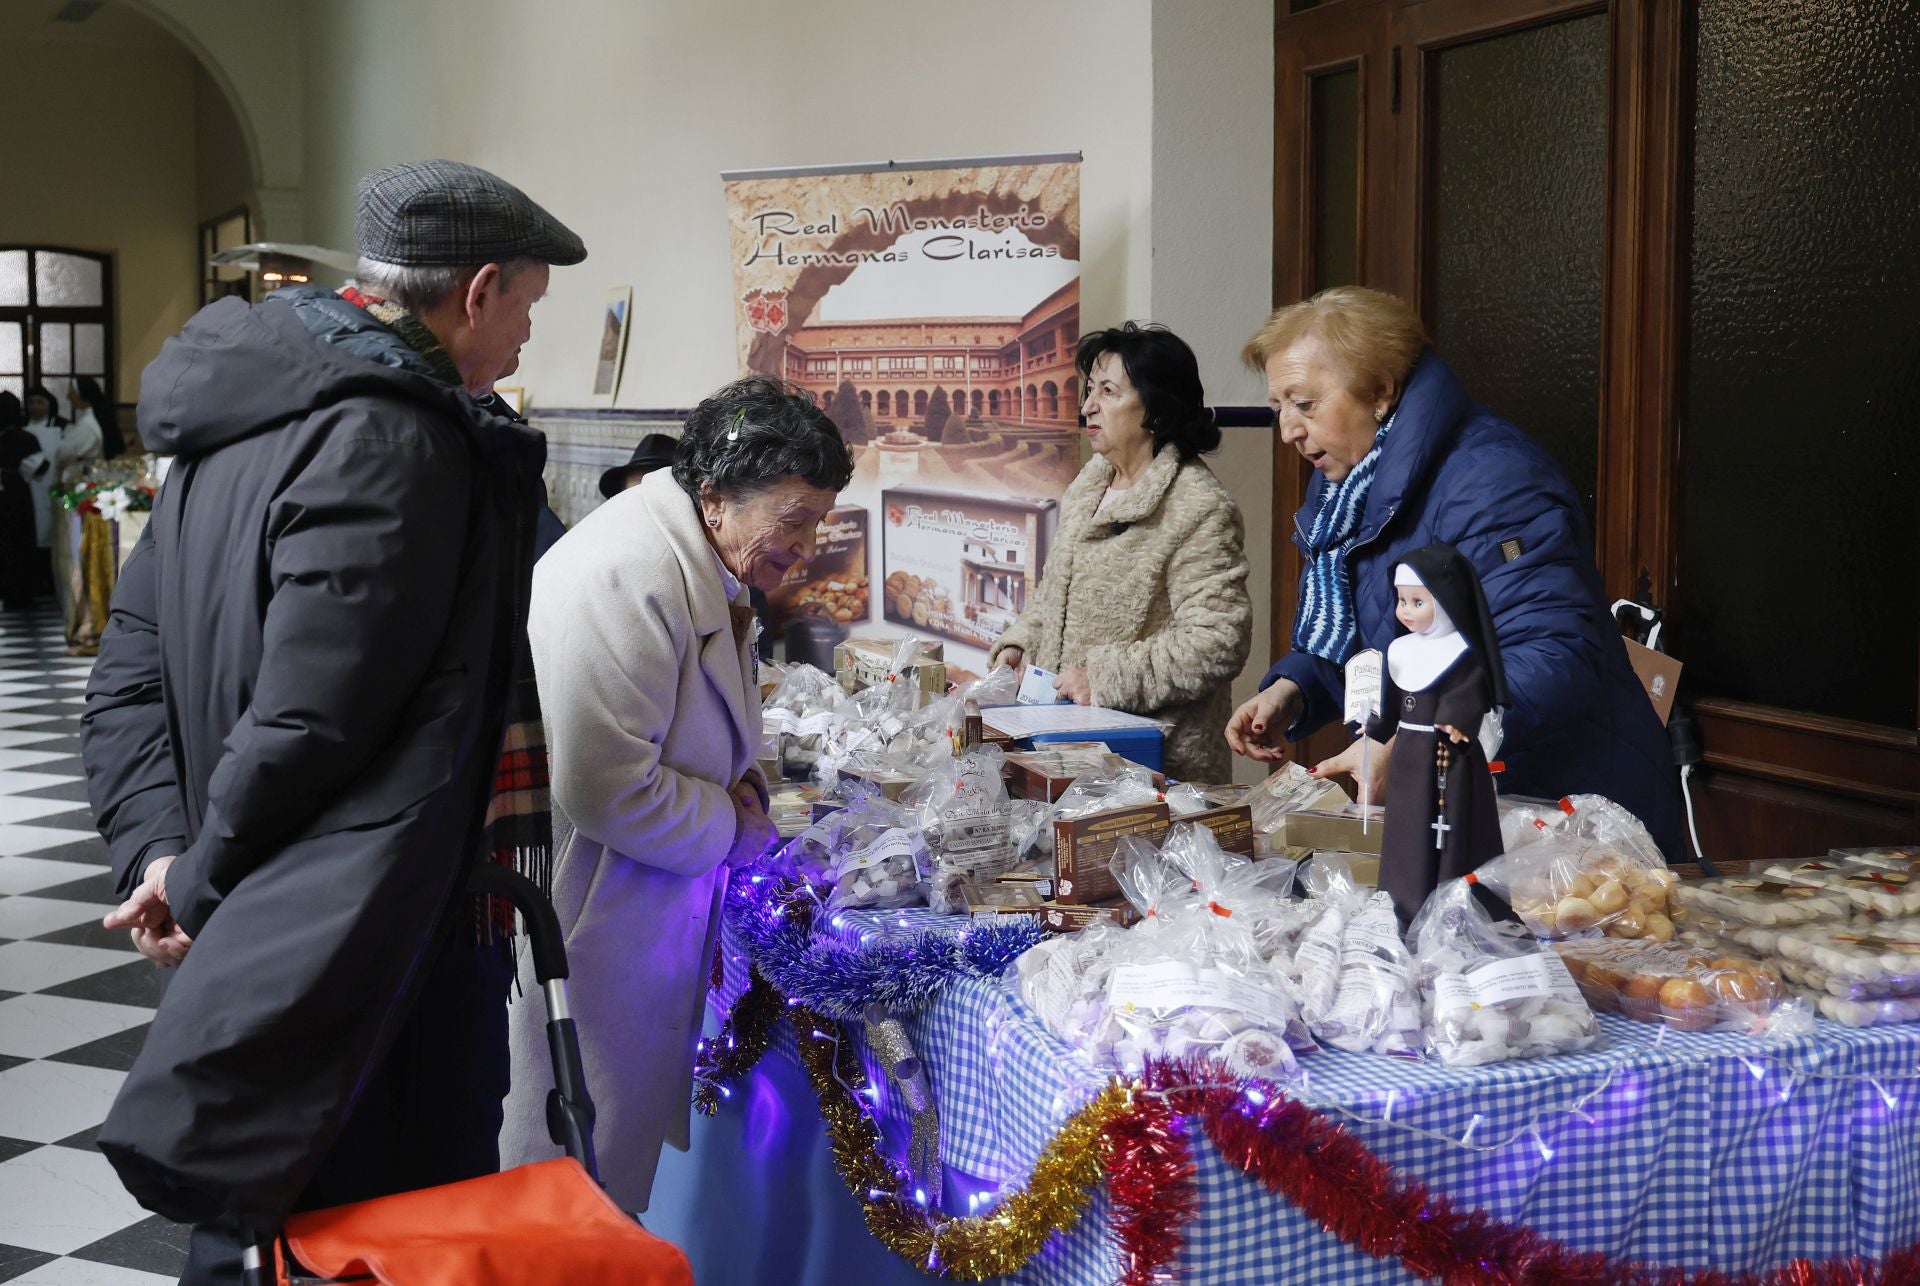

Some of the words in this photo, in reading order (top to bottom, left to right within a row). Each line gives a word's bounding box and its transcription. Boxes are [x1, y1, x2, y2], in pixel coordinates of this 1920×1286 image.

[751, 211, 838, 237] Real
[852, 206, 1047, 234] Monasterio
[743, 241, 909, 267] Hermanas
[921, 235, 1058, 261] Clarisas
[907, 506, 937, 521] Real
[942, 510, 1017, 533] Monasterio
[907, 520, 967, 536] Hermanas
[972, 527, 1026, 546] Clarisas
